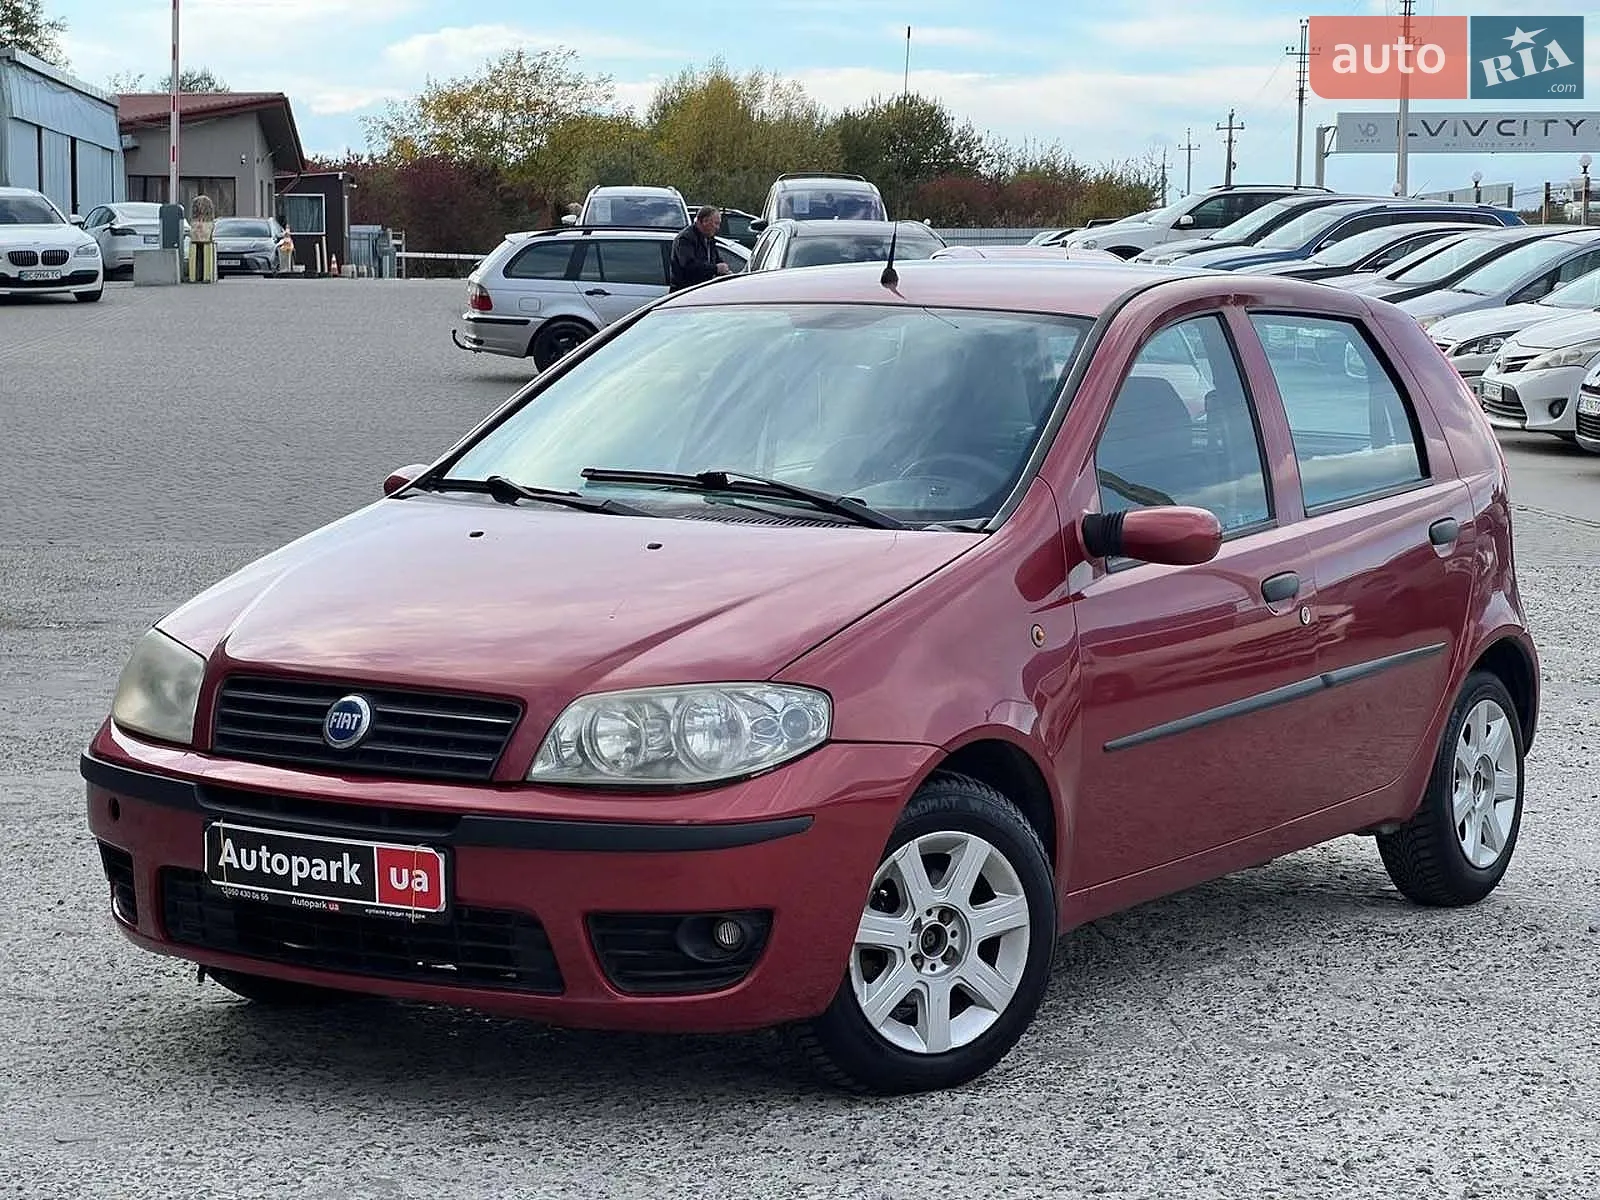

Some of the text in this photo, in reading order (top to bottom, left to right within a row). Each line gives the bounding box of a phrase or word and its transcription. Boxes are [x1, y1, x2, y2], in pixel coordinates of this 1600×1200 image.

[329, 711, 361, 730] FIAT
[218, 838, 429, 892] Autopark ua
[292, 897, 340, 911] Autopark ua
